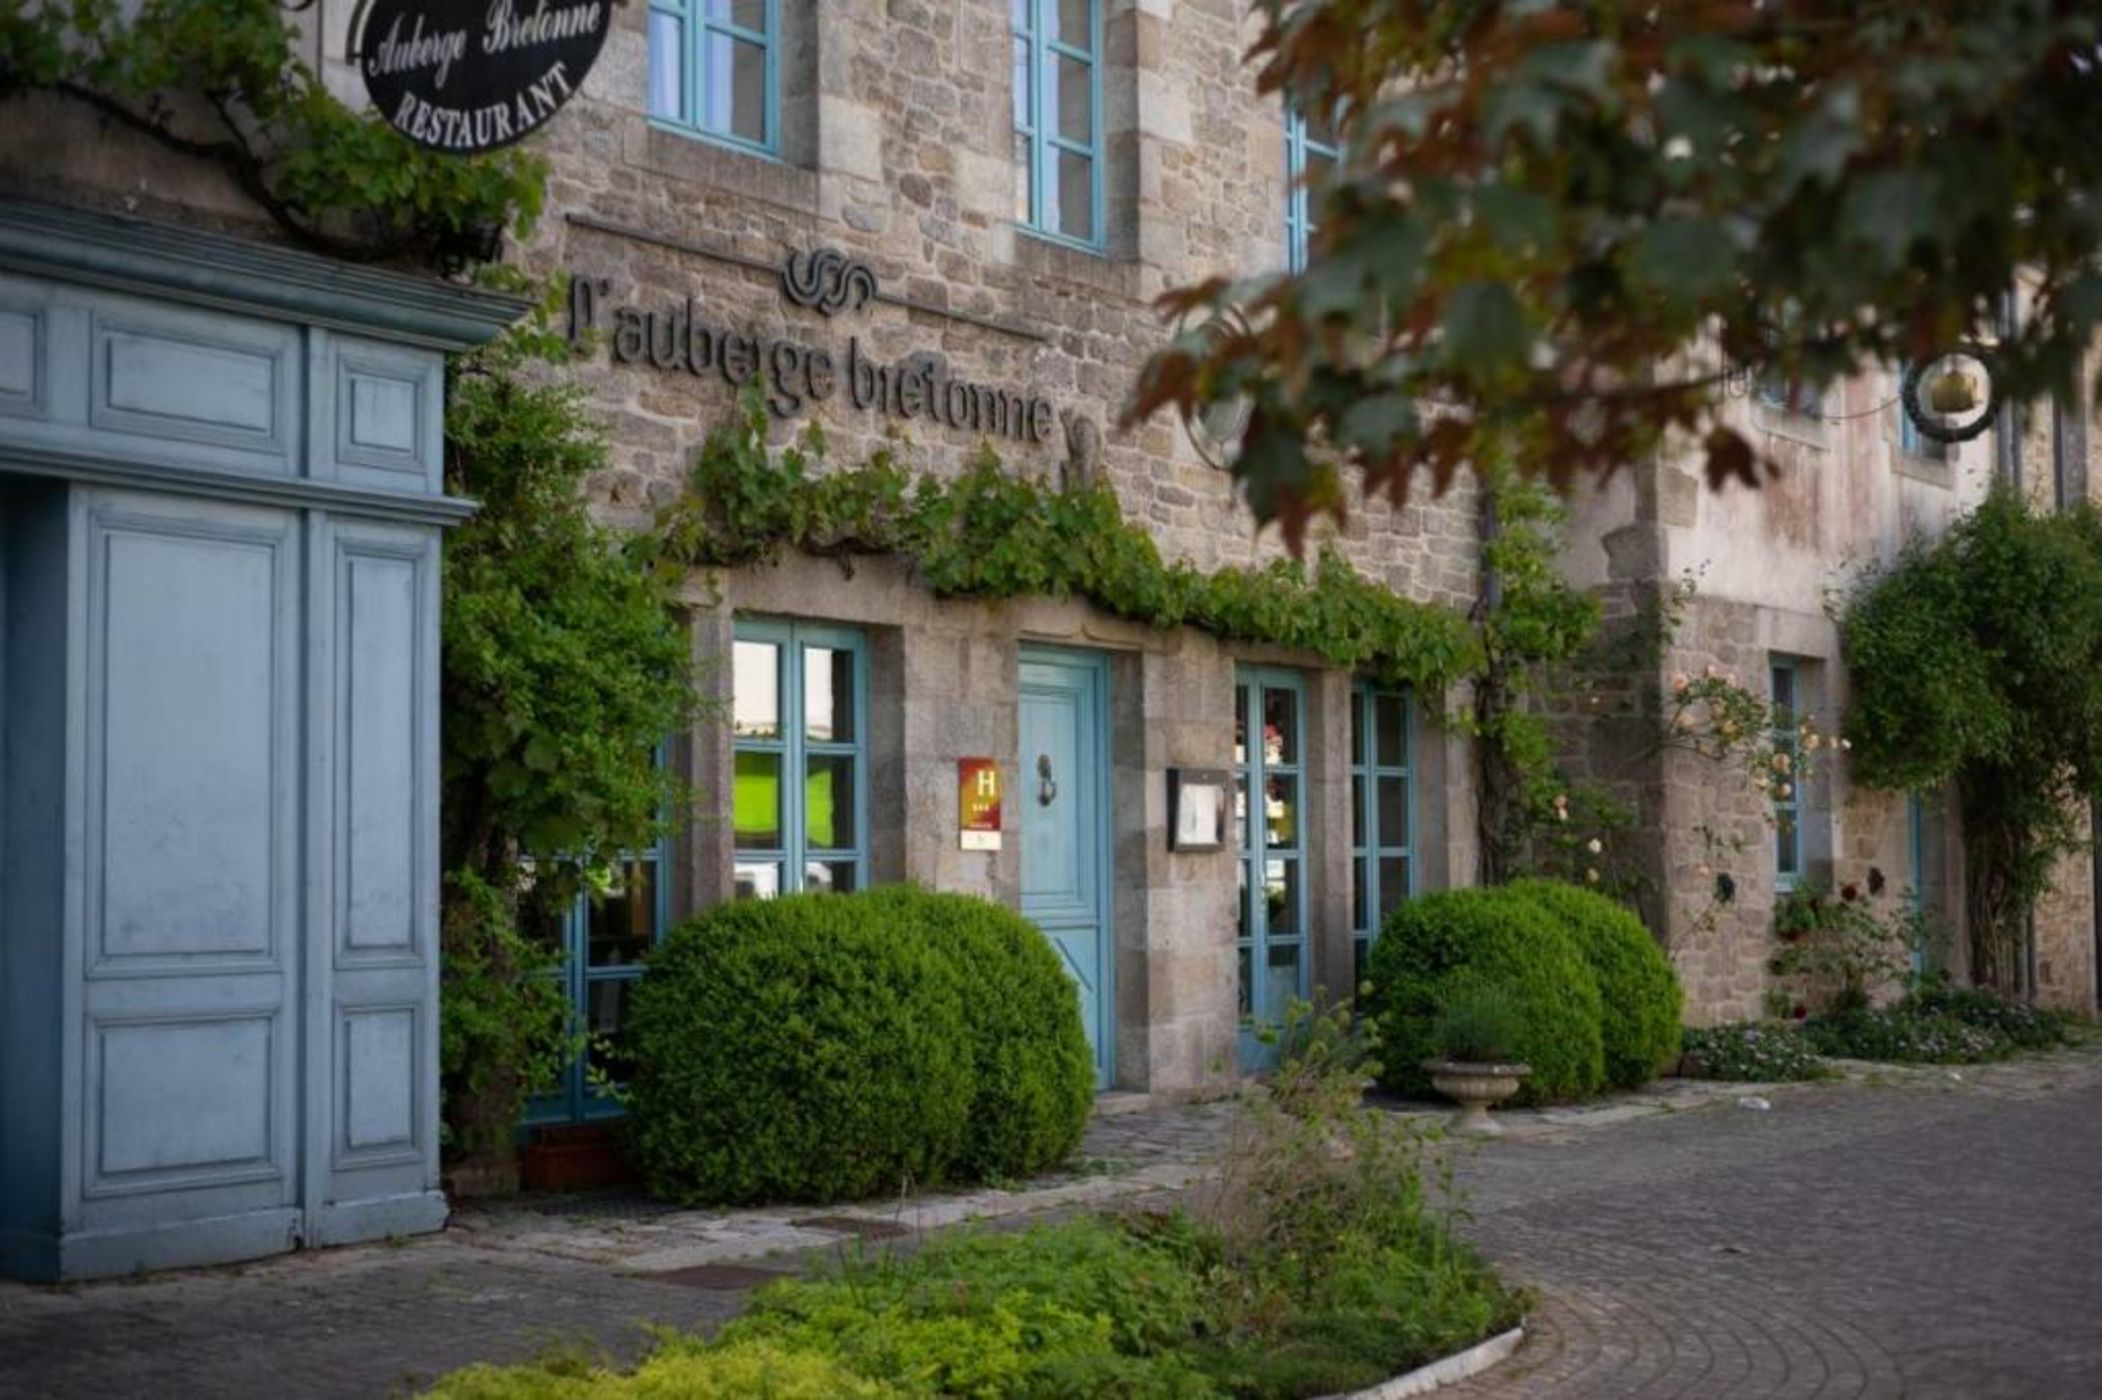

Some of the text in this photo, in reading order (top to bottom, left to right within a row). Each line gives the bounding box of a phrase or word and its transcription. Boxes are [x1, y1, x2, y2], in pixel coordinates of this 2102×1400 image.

[368, 0, 600, 89] Auberge Bretonne
[393, 60, 571, 148] RESTAURANT
[848, 336, 1053, 443] bretonne
[977, 770, 995, 796] H
